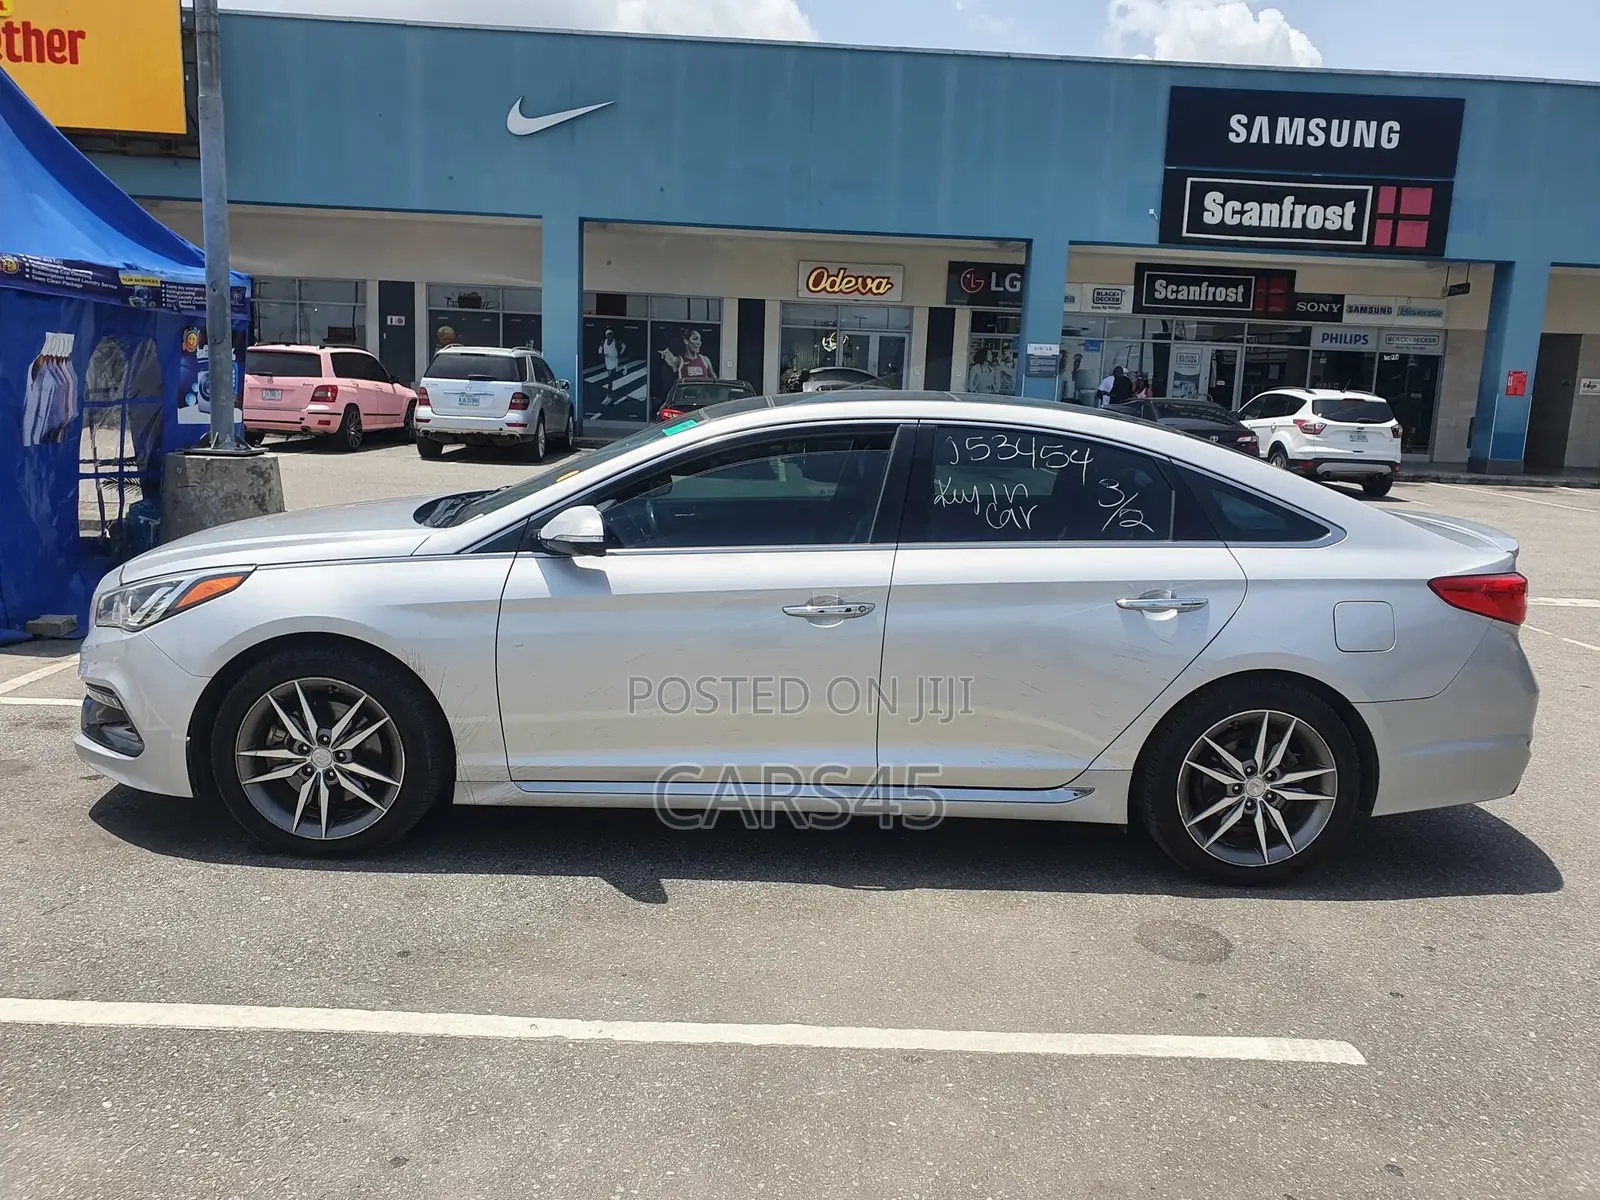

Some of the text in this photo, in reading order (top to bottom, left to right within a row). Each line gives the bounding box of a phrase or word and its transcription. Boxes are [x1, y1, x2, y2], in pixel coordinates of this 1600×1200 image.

[0, 21, 86, 65] ther
[1228, 113, 1400, 149] SAMSUNG
[1203, 191, 1356, 231] Scanfrost
[806, 266, 894, 296] Odeva
[990, 271, 1022, 292] LG
[1154, 279, 1244, 303] Scanfrost
[1296, 301, 1341, 313] SONY
[1346, 304, 1393, 316] SAMSUNG
[1397, 305, 1443, 318] Hisense
[1321, 332, 1369, 345] PHILIPS
